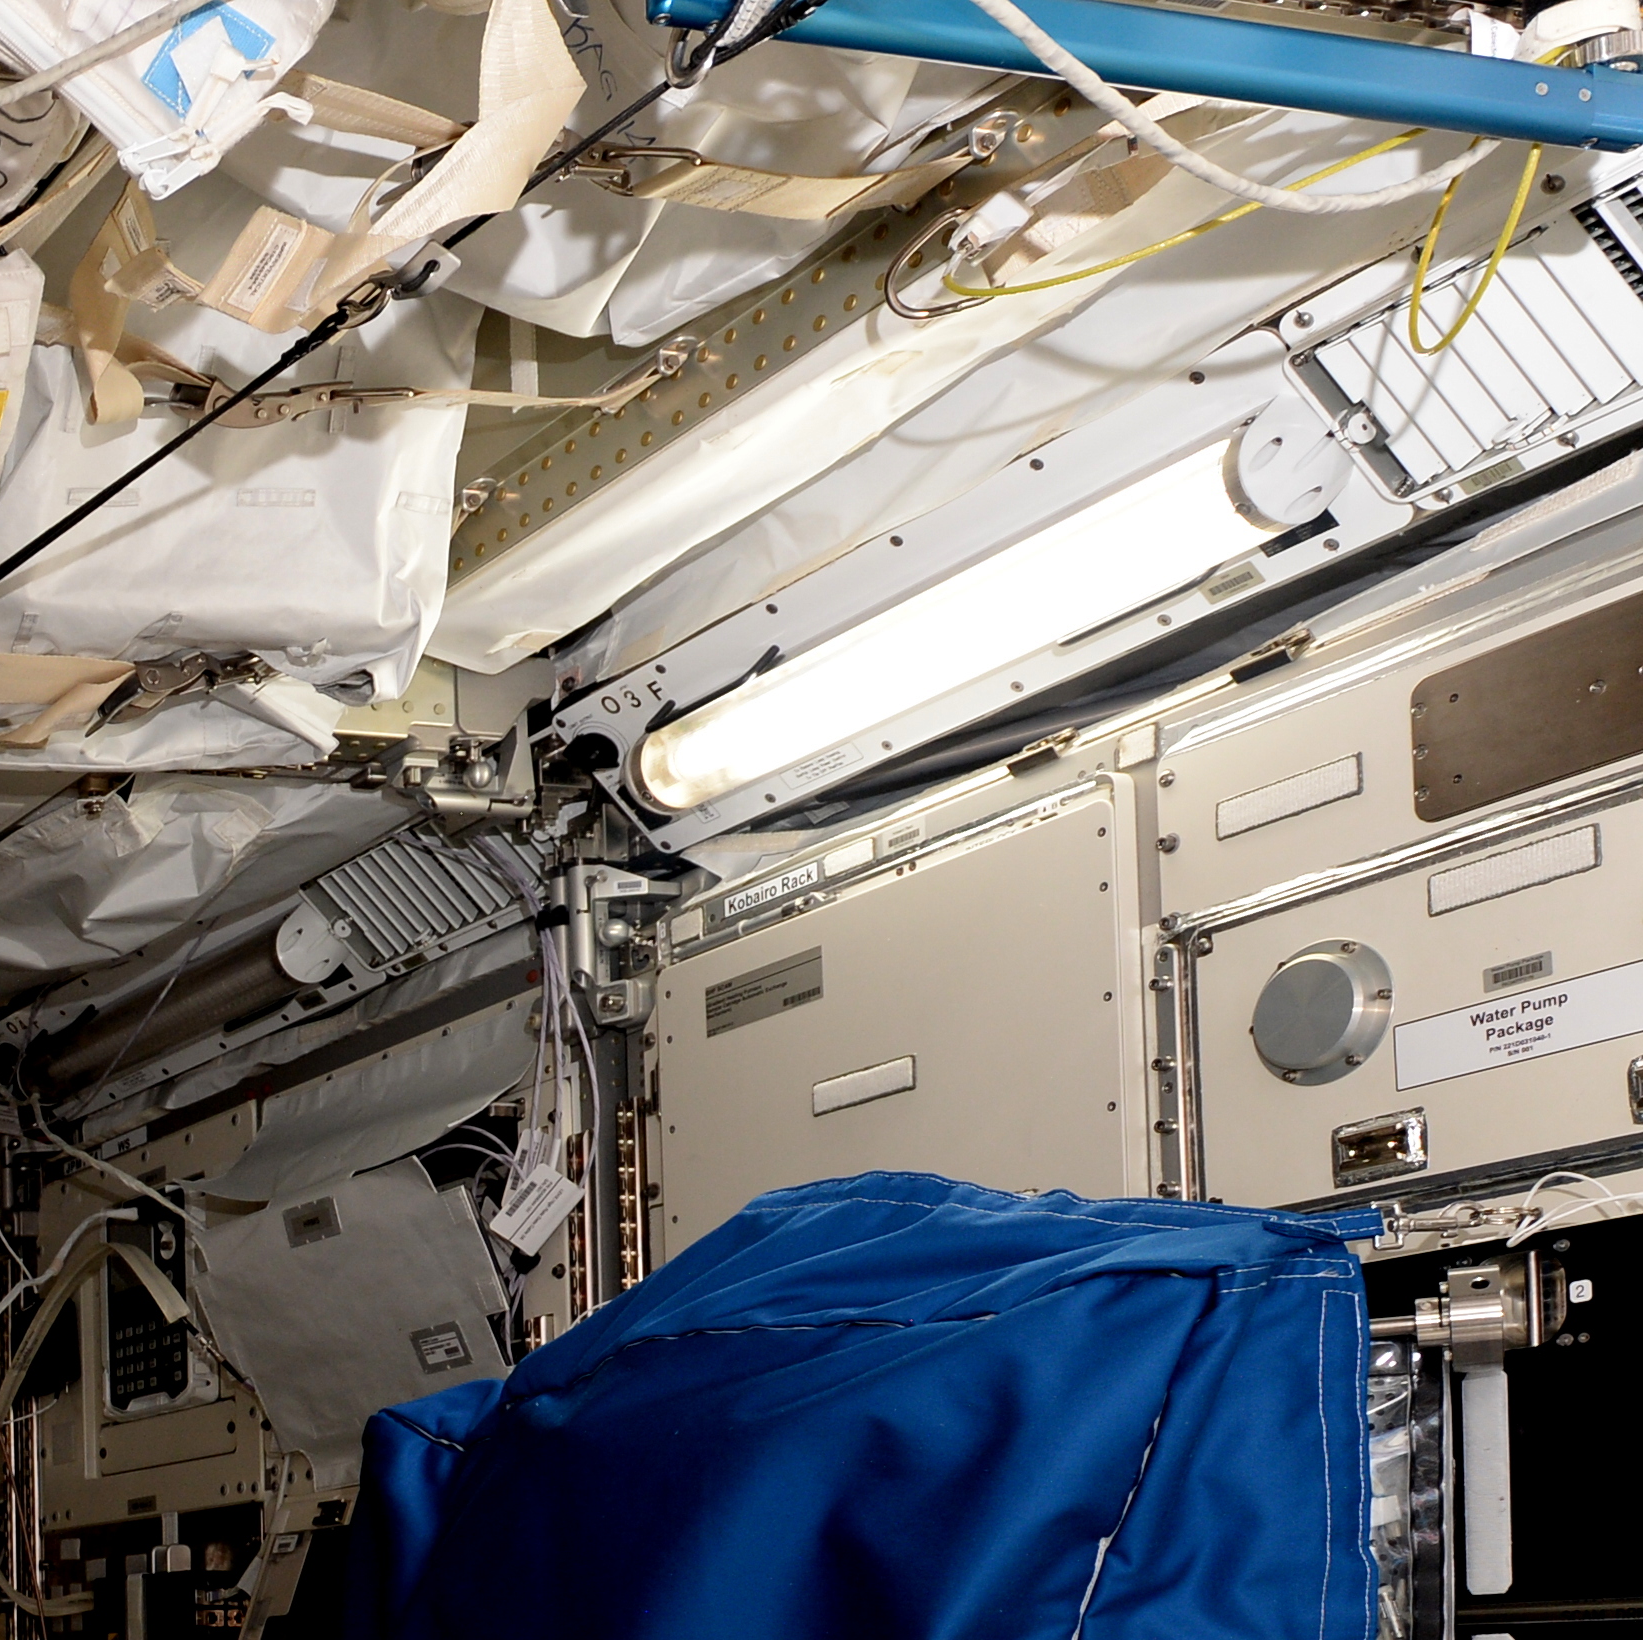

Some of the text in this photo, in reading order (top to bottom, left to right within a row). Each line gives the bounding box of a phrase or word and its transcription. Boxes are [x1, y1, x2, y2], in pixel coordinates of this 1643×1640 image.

[727, 868, 814, 915] Kobairo Rack
[1469, 993, 1568, 1027] Water Pump
[1485, 1014, 1554, 1041] Package
[117, 1136, 131, 1151] WS
[1574, 1284, 1586, 1299] 2
